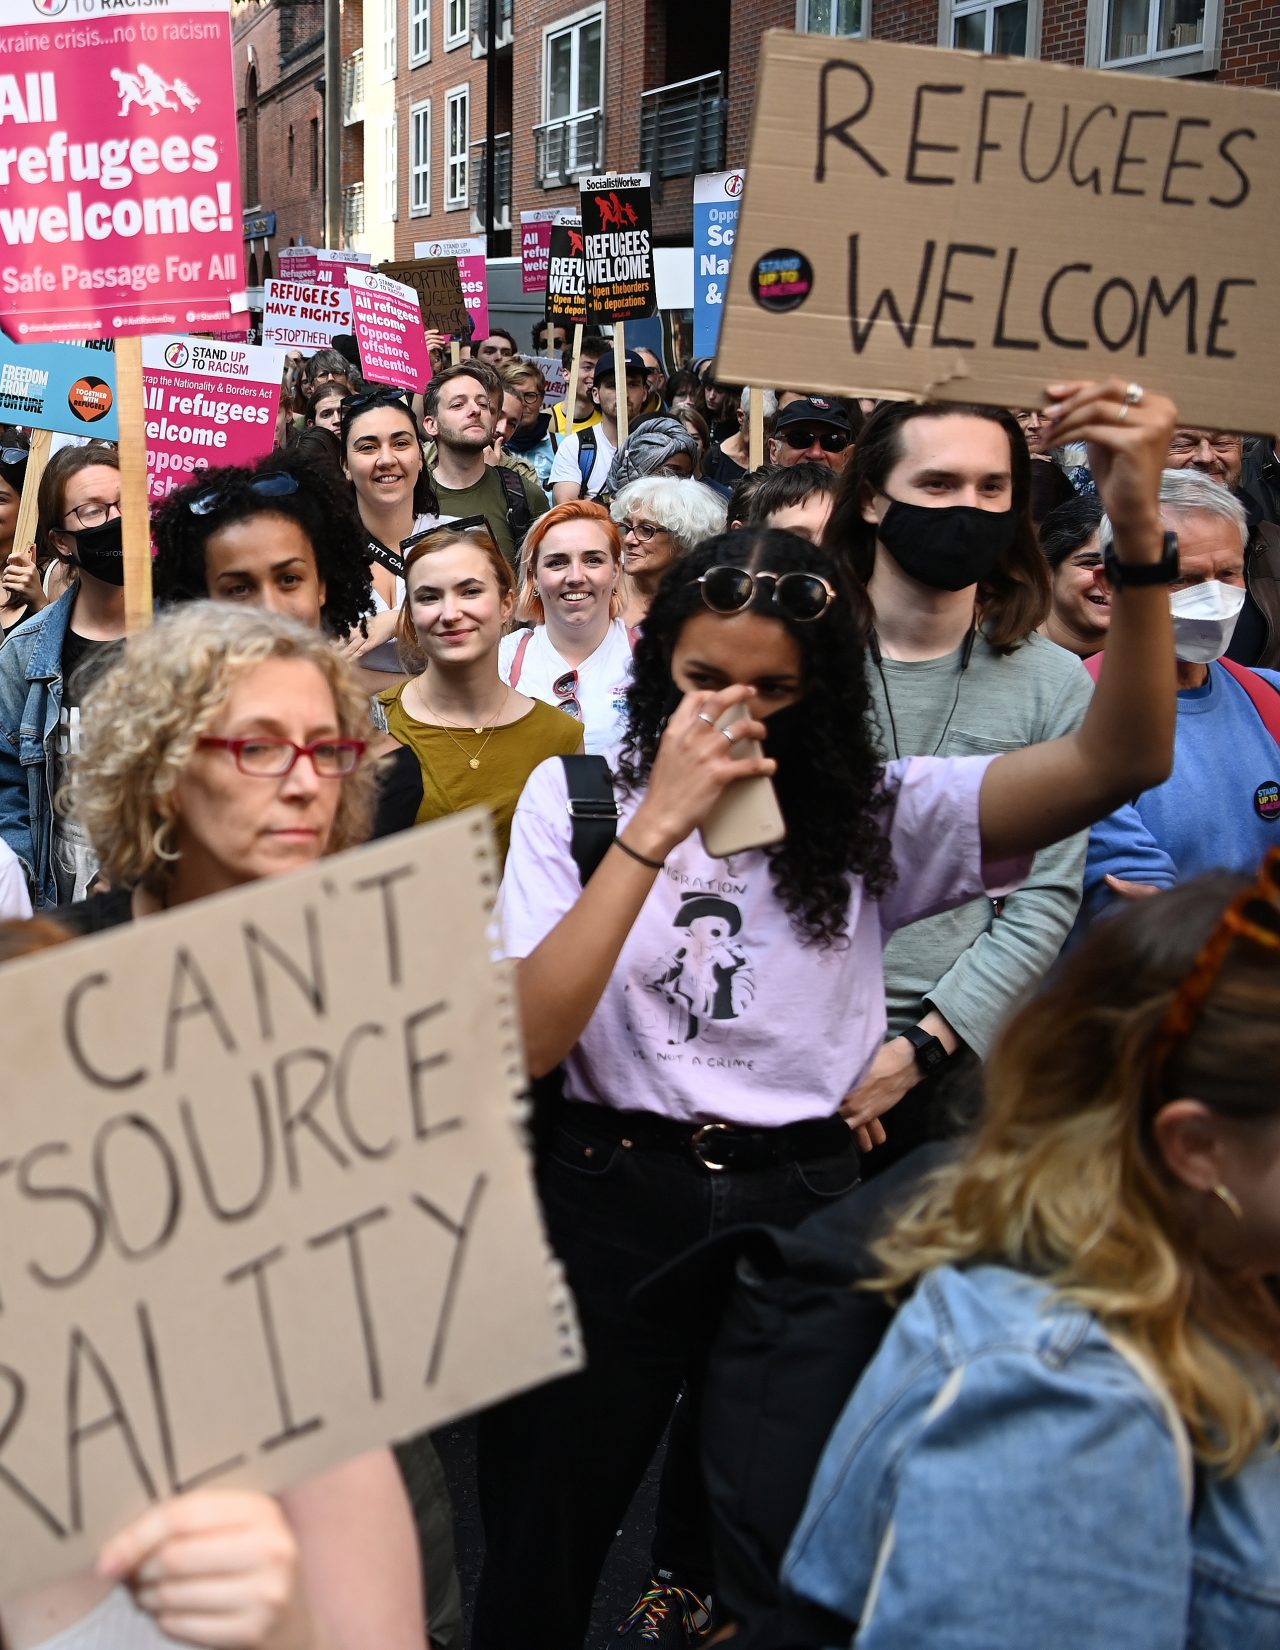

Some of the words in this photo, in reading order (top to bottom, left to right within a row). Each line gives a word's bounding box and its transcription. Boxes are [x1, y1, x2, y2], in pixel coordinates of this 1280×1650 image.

[142, 21, 157, 41] to
[163, 19, 220, 40] racism
[815, 59, 1257, 208] REFUGEES
[524, 233, 538, 245] All
[585, 230, 650, 259] REFUGEES
[2, 265, 56, 294] Safe
[62, 260, 160, 291] Passage
[166, 256, 203, 284] For
[208, 254, 237, 281] All
[281, 269, 316, 279] Refugees
[551, 257, 584, 277] REFU
[586, 255, 650, 284] WELCOME
[700, 254, 732, 276] Na
[317, 270, 332, 282] All
[379, 279, 394, 288] STAND
[549, 275, 585, 294] WELC
[270, 282, 340, 307] REFUGEES
[388, 287, 405, 298] RACISM
[554, 294, 571, 304] Open
[593, 285, 610, 297] Open
[706, 283, 722, 304] &
[849, 232, 1257, 359] WELCOME
[266, 302, 297, 316] HAVE
[301, 307, 350, 326] RIGHTS
[355, 295, 372, 310] All
[374, 300, 420, 324] refugees
[553, 305, 562, 314] No
[594, 299, 602, 310] No
[357, 311, 406, 332] welcome
[360, 324, 402, 344] Oppose
[192, 347, 227, 361] STAND
[230, 352, 246, 363] UP
[362, 340, 410, 361] offshore
[2, 363, 49, 386] FREEDOM
[192, 359, 205, 370] TO
[208, 362, 249, 375] RACISM
[364, 353, 418, 377] detention
[0, 378, 29, 396] FROM
[76, 388, 108, 399] TOGETHER
[160, 375, 172, 386] the
[174, 378, 215, 394] Nationality
[217, 385, 224, 393] &
[226, 384, 257, 397] Borders
[259, 389, 273, 399] Act
[73, 399, 105, 411] REFUGEES
[82, 395, 99, 404] WITH
[169, 393, 269, 425] refugees
[1258, 787, 1278, 797] STAND
[62, 863, 418, 1092] CAN'T
[657, 1052, 684, 1062] NOT
[692, 1056, 701, 1066] A
[706, 1057, 756, 1071] CRIME
